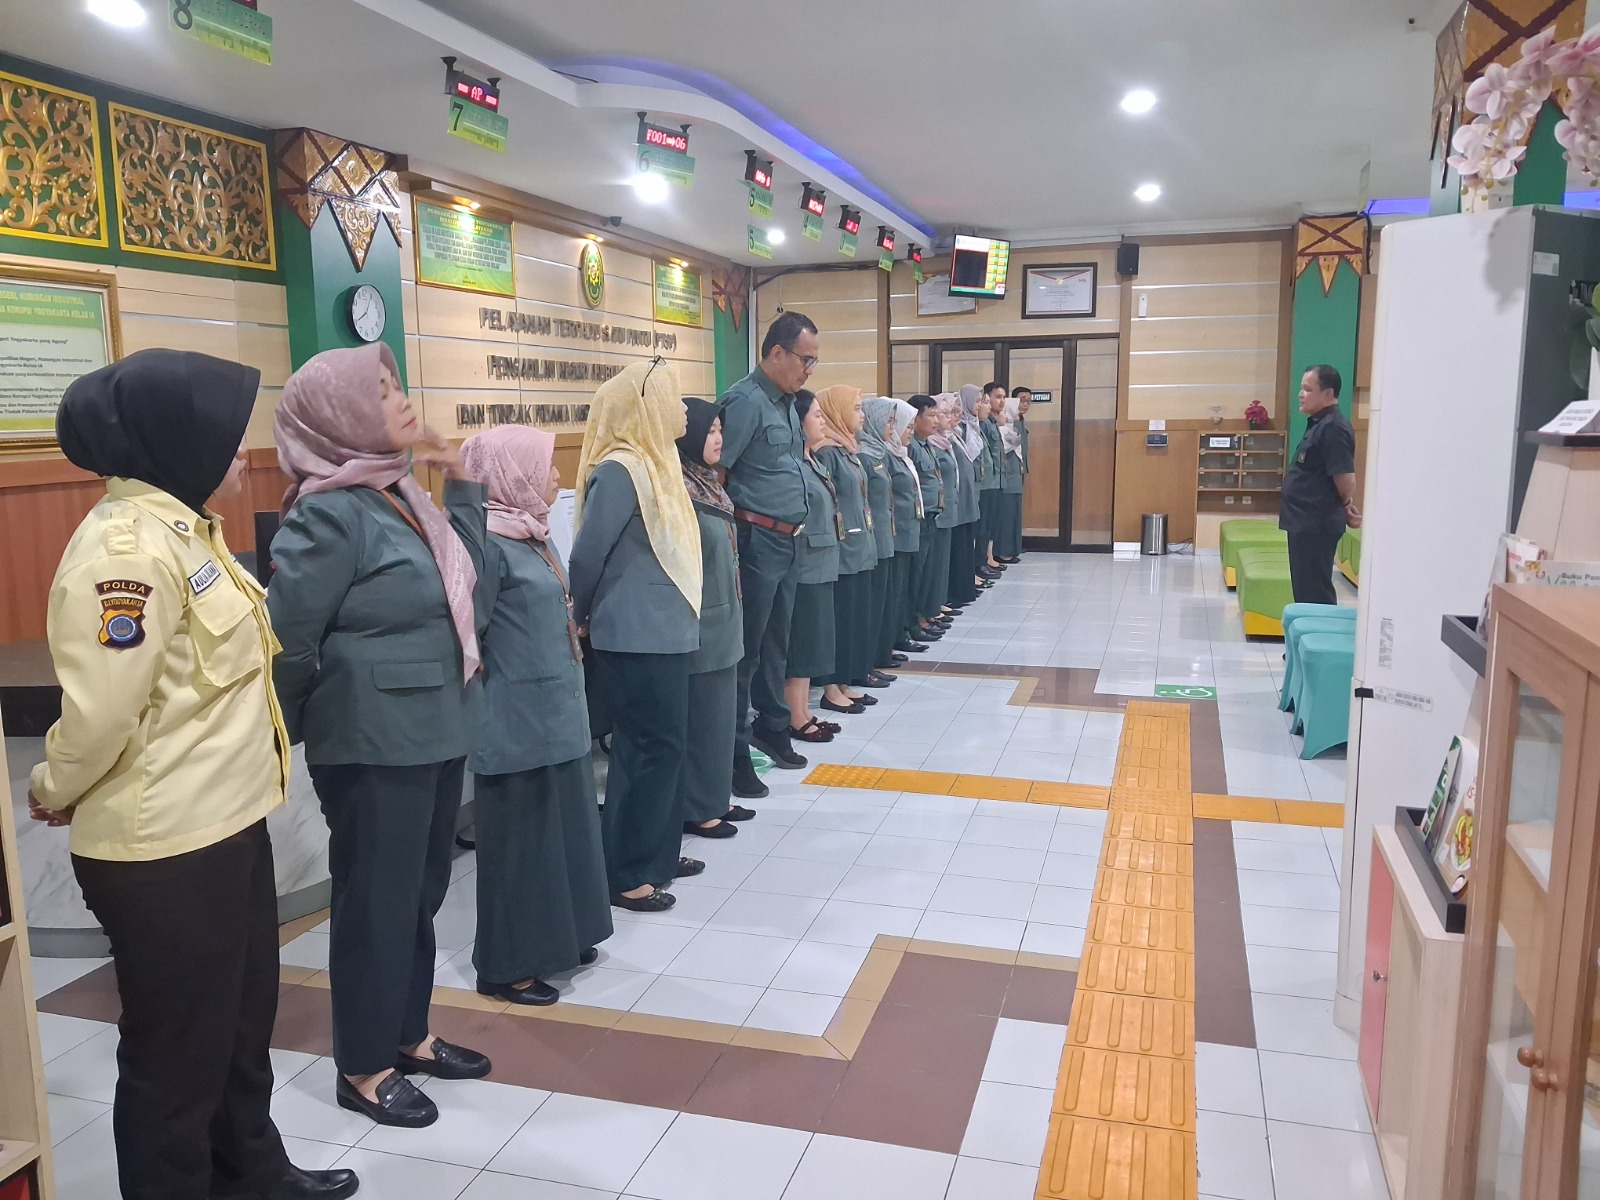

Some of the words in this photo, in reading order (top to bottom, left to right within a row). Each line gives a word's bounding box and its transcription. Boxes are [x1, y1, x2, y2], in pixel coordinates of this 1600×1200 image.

[173, 0, 193, 30] 8
[452, 101, 464, 131] 7
[639, 150, 650, 173] 6
[103, 581, 146, 594] POLDA
